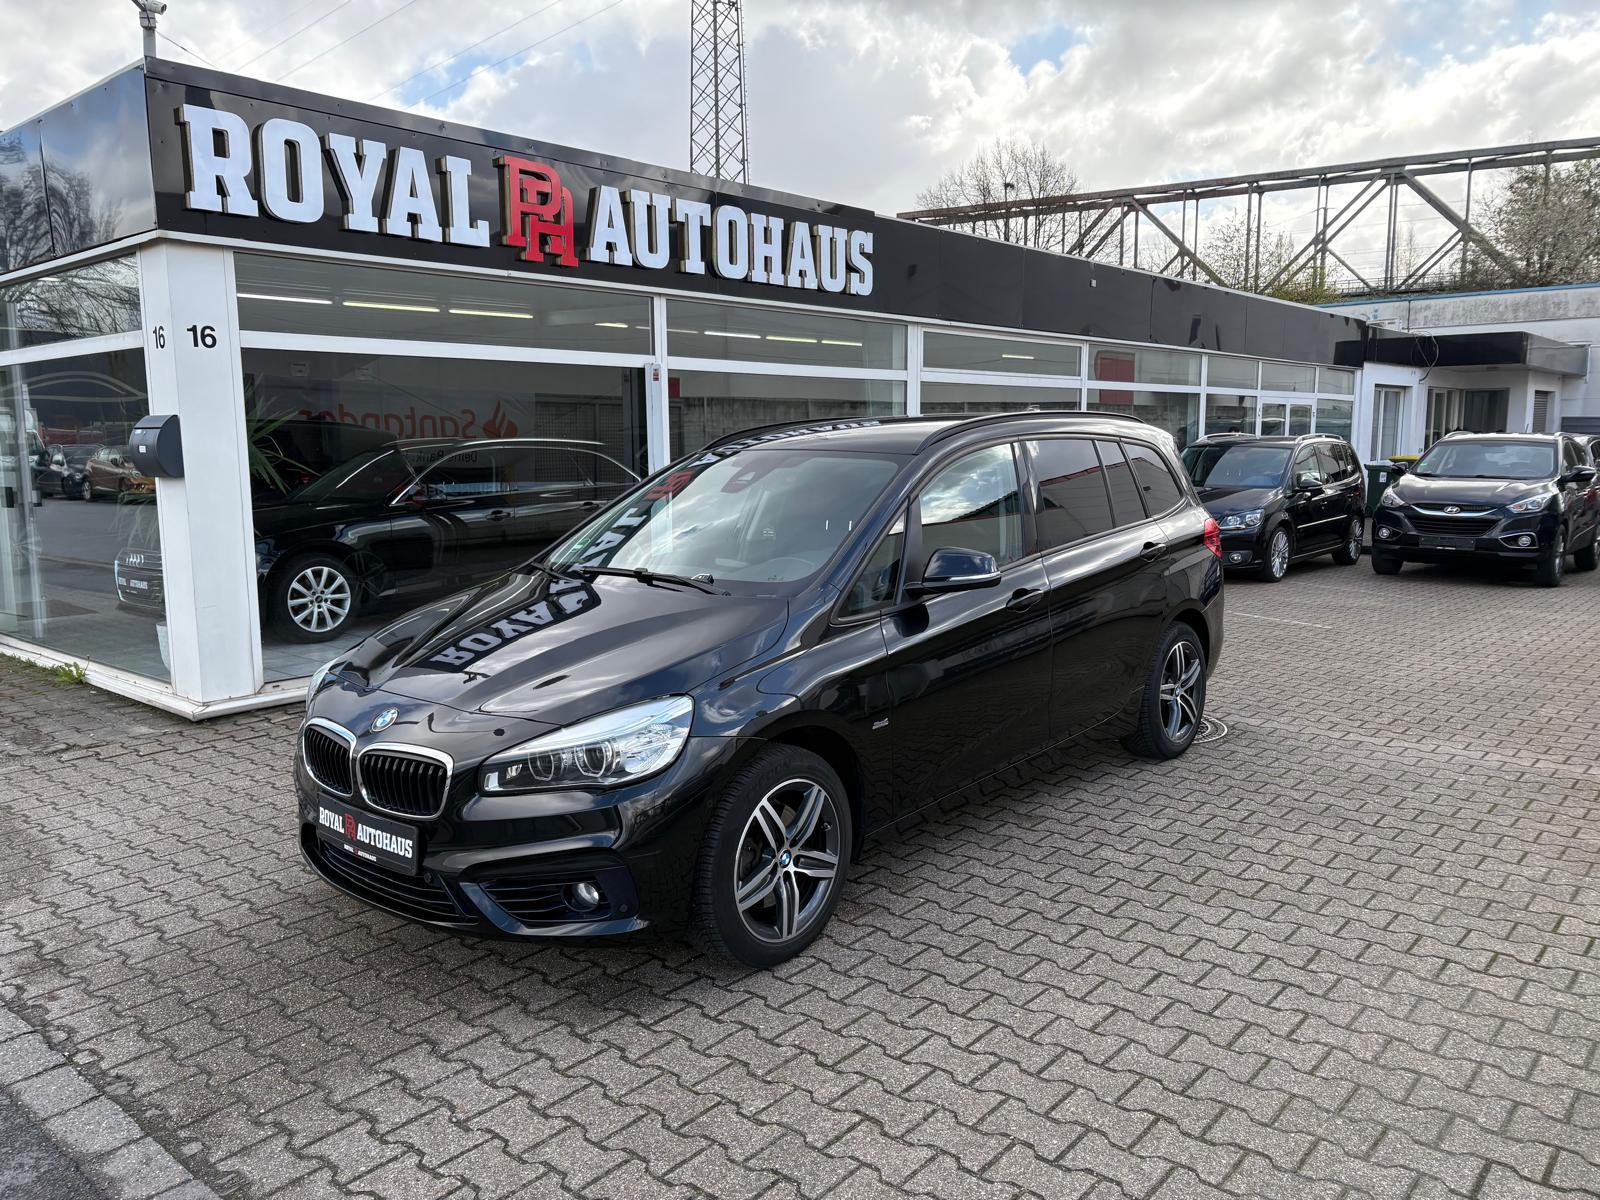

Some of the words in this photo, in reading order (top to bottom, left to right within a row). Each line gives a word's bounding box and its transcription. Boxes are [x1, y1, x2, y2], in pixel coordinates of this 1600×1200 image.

[177, 103, 490, 248] ROYAL
[588, 185, 874, 297] AUTOHAUS
[152, 325, 166, 349] 16
[186, 324, 217, 349] 16
[319, 807, 344, 833] ROYAL
[357, 824, 412, 858] AUTOHAUS
